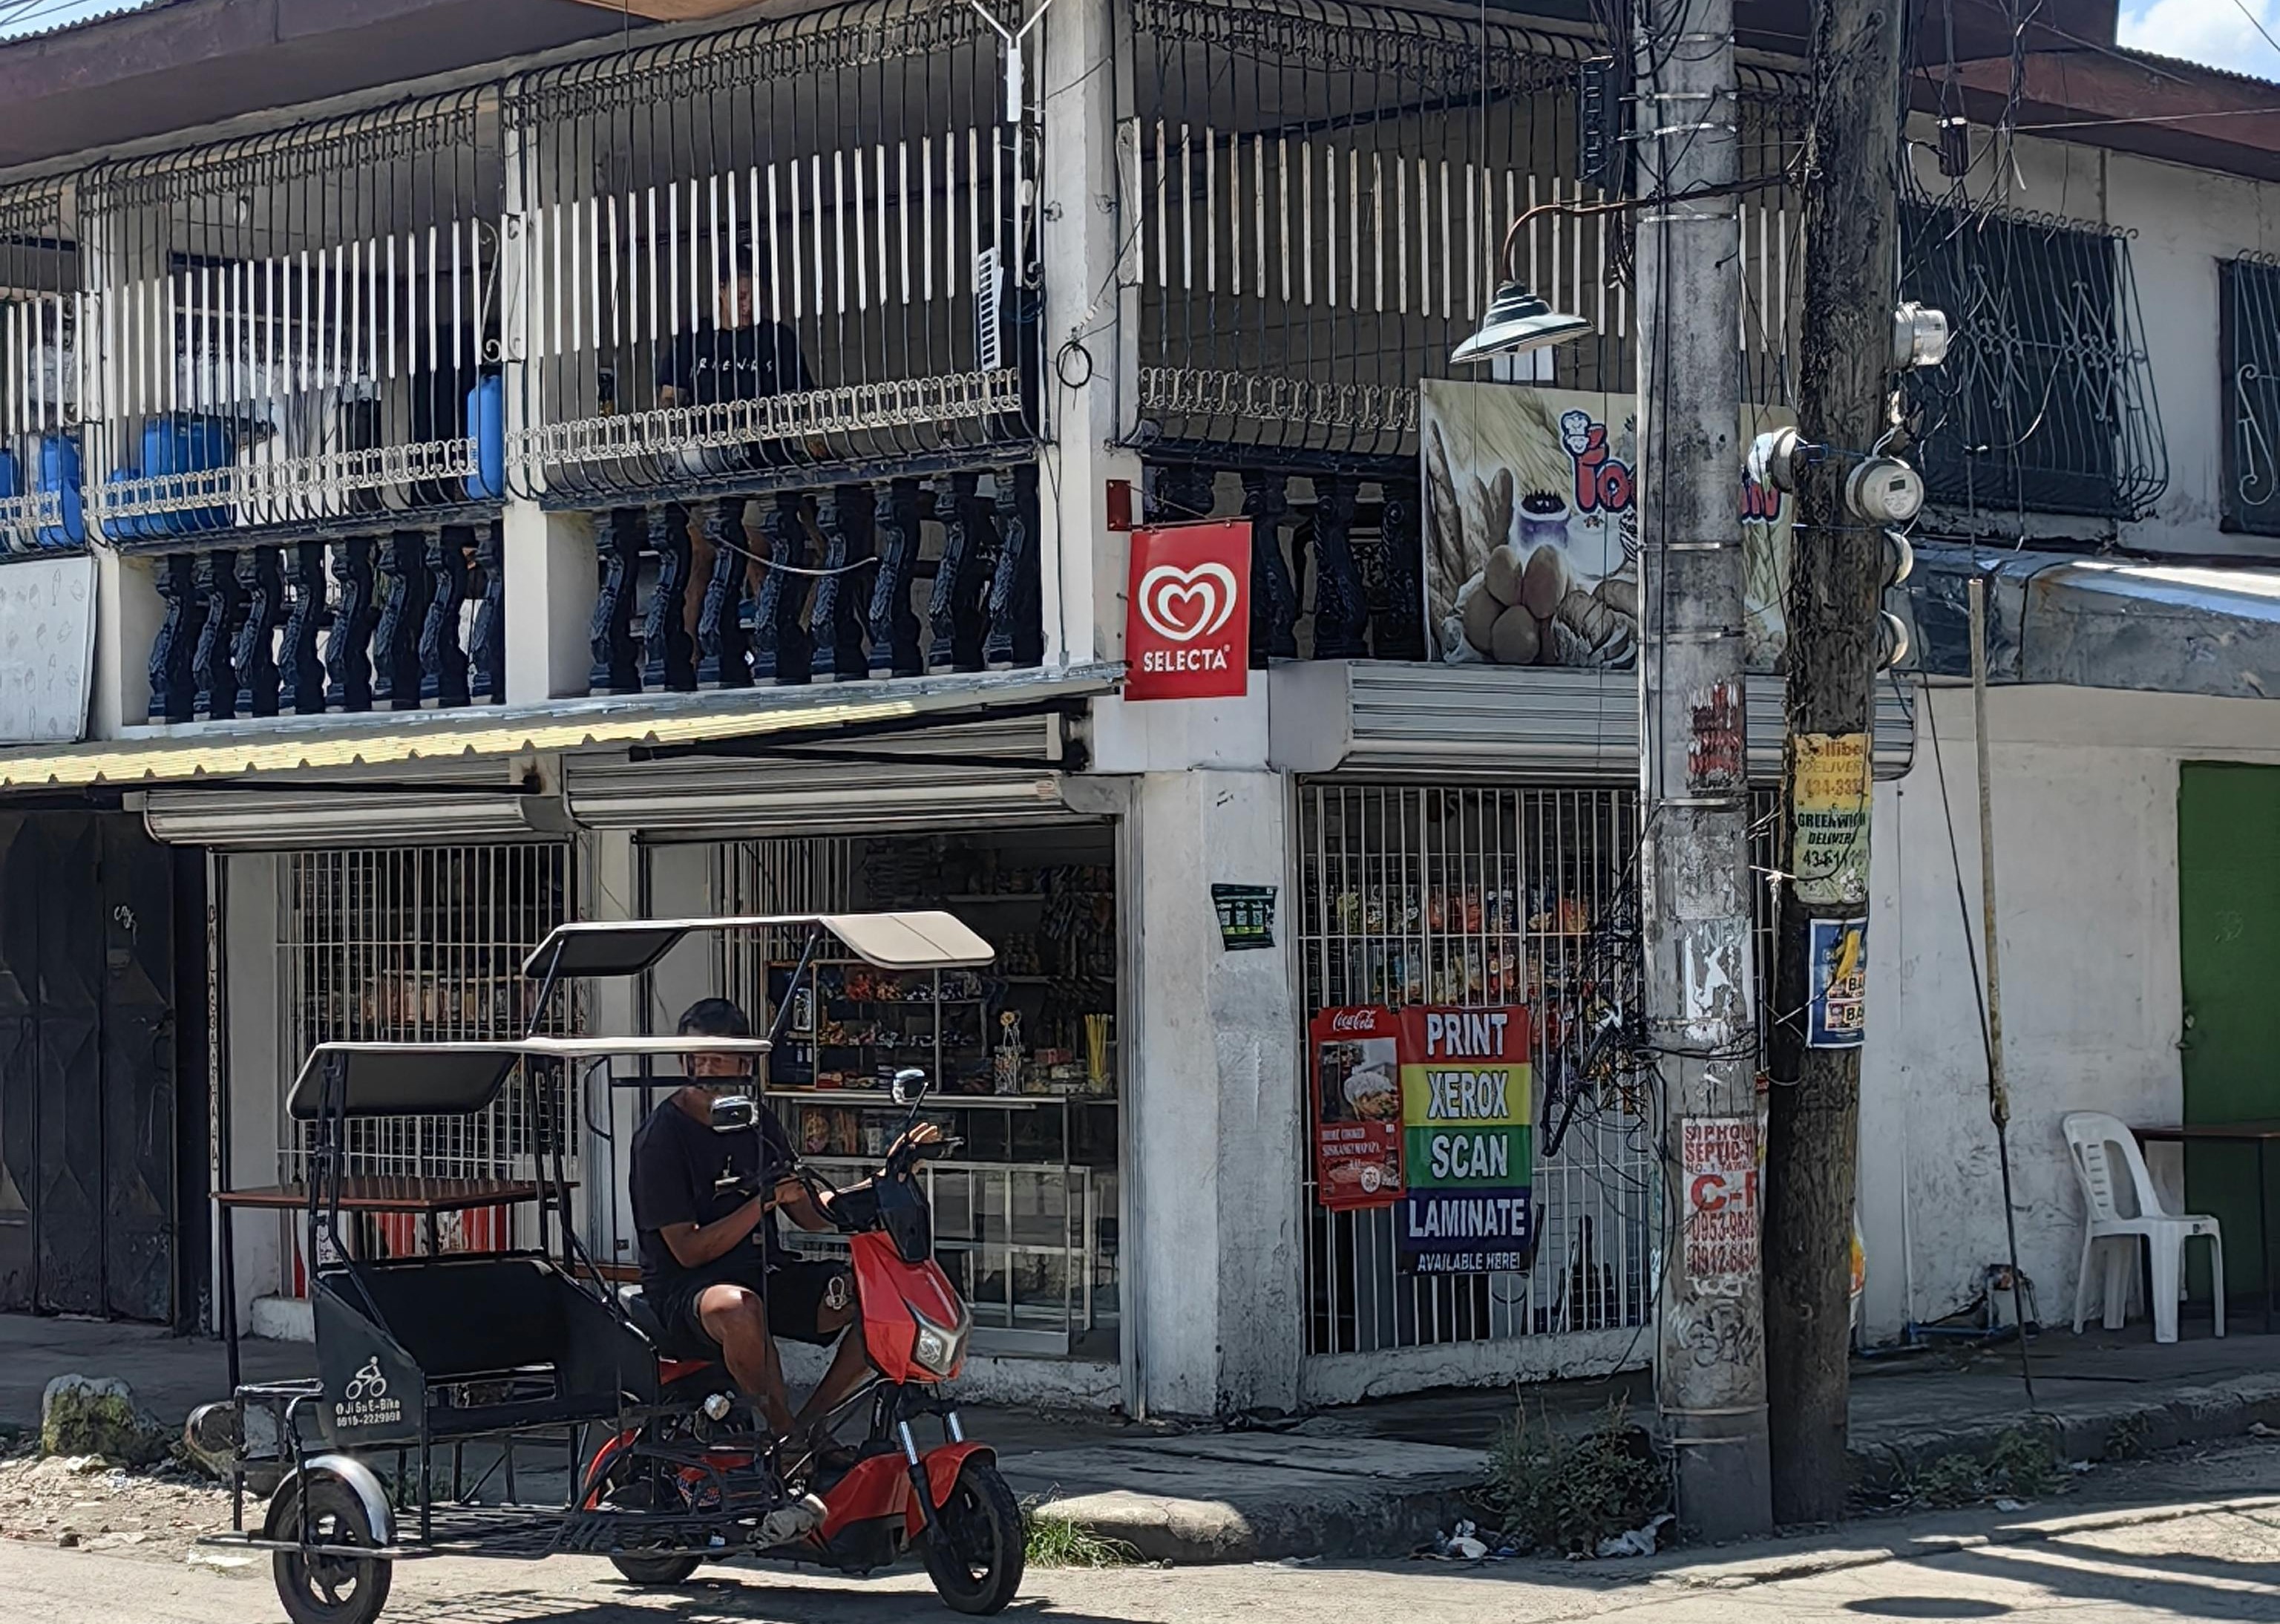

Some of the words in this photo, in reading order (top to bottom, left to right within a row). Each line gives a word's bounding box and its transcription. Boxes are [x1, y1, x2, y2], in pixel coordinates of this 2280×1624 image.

[1143, 649, 1228, 672] SELECTA
[1426, 1012, 1508, 1056] PRINT
[1426, 1072, 1509, 1119] XEROX
[1431, 1134, 1508, 1179] SCAN
[1409, 1199, 1525, 1237] LAMINATE
[1417, 1253, 1483, 1271] AVAILABLE
